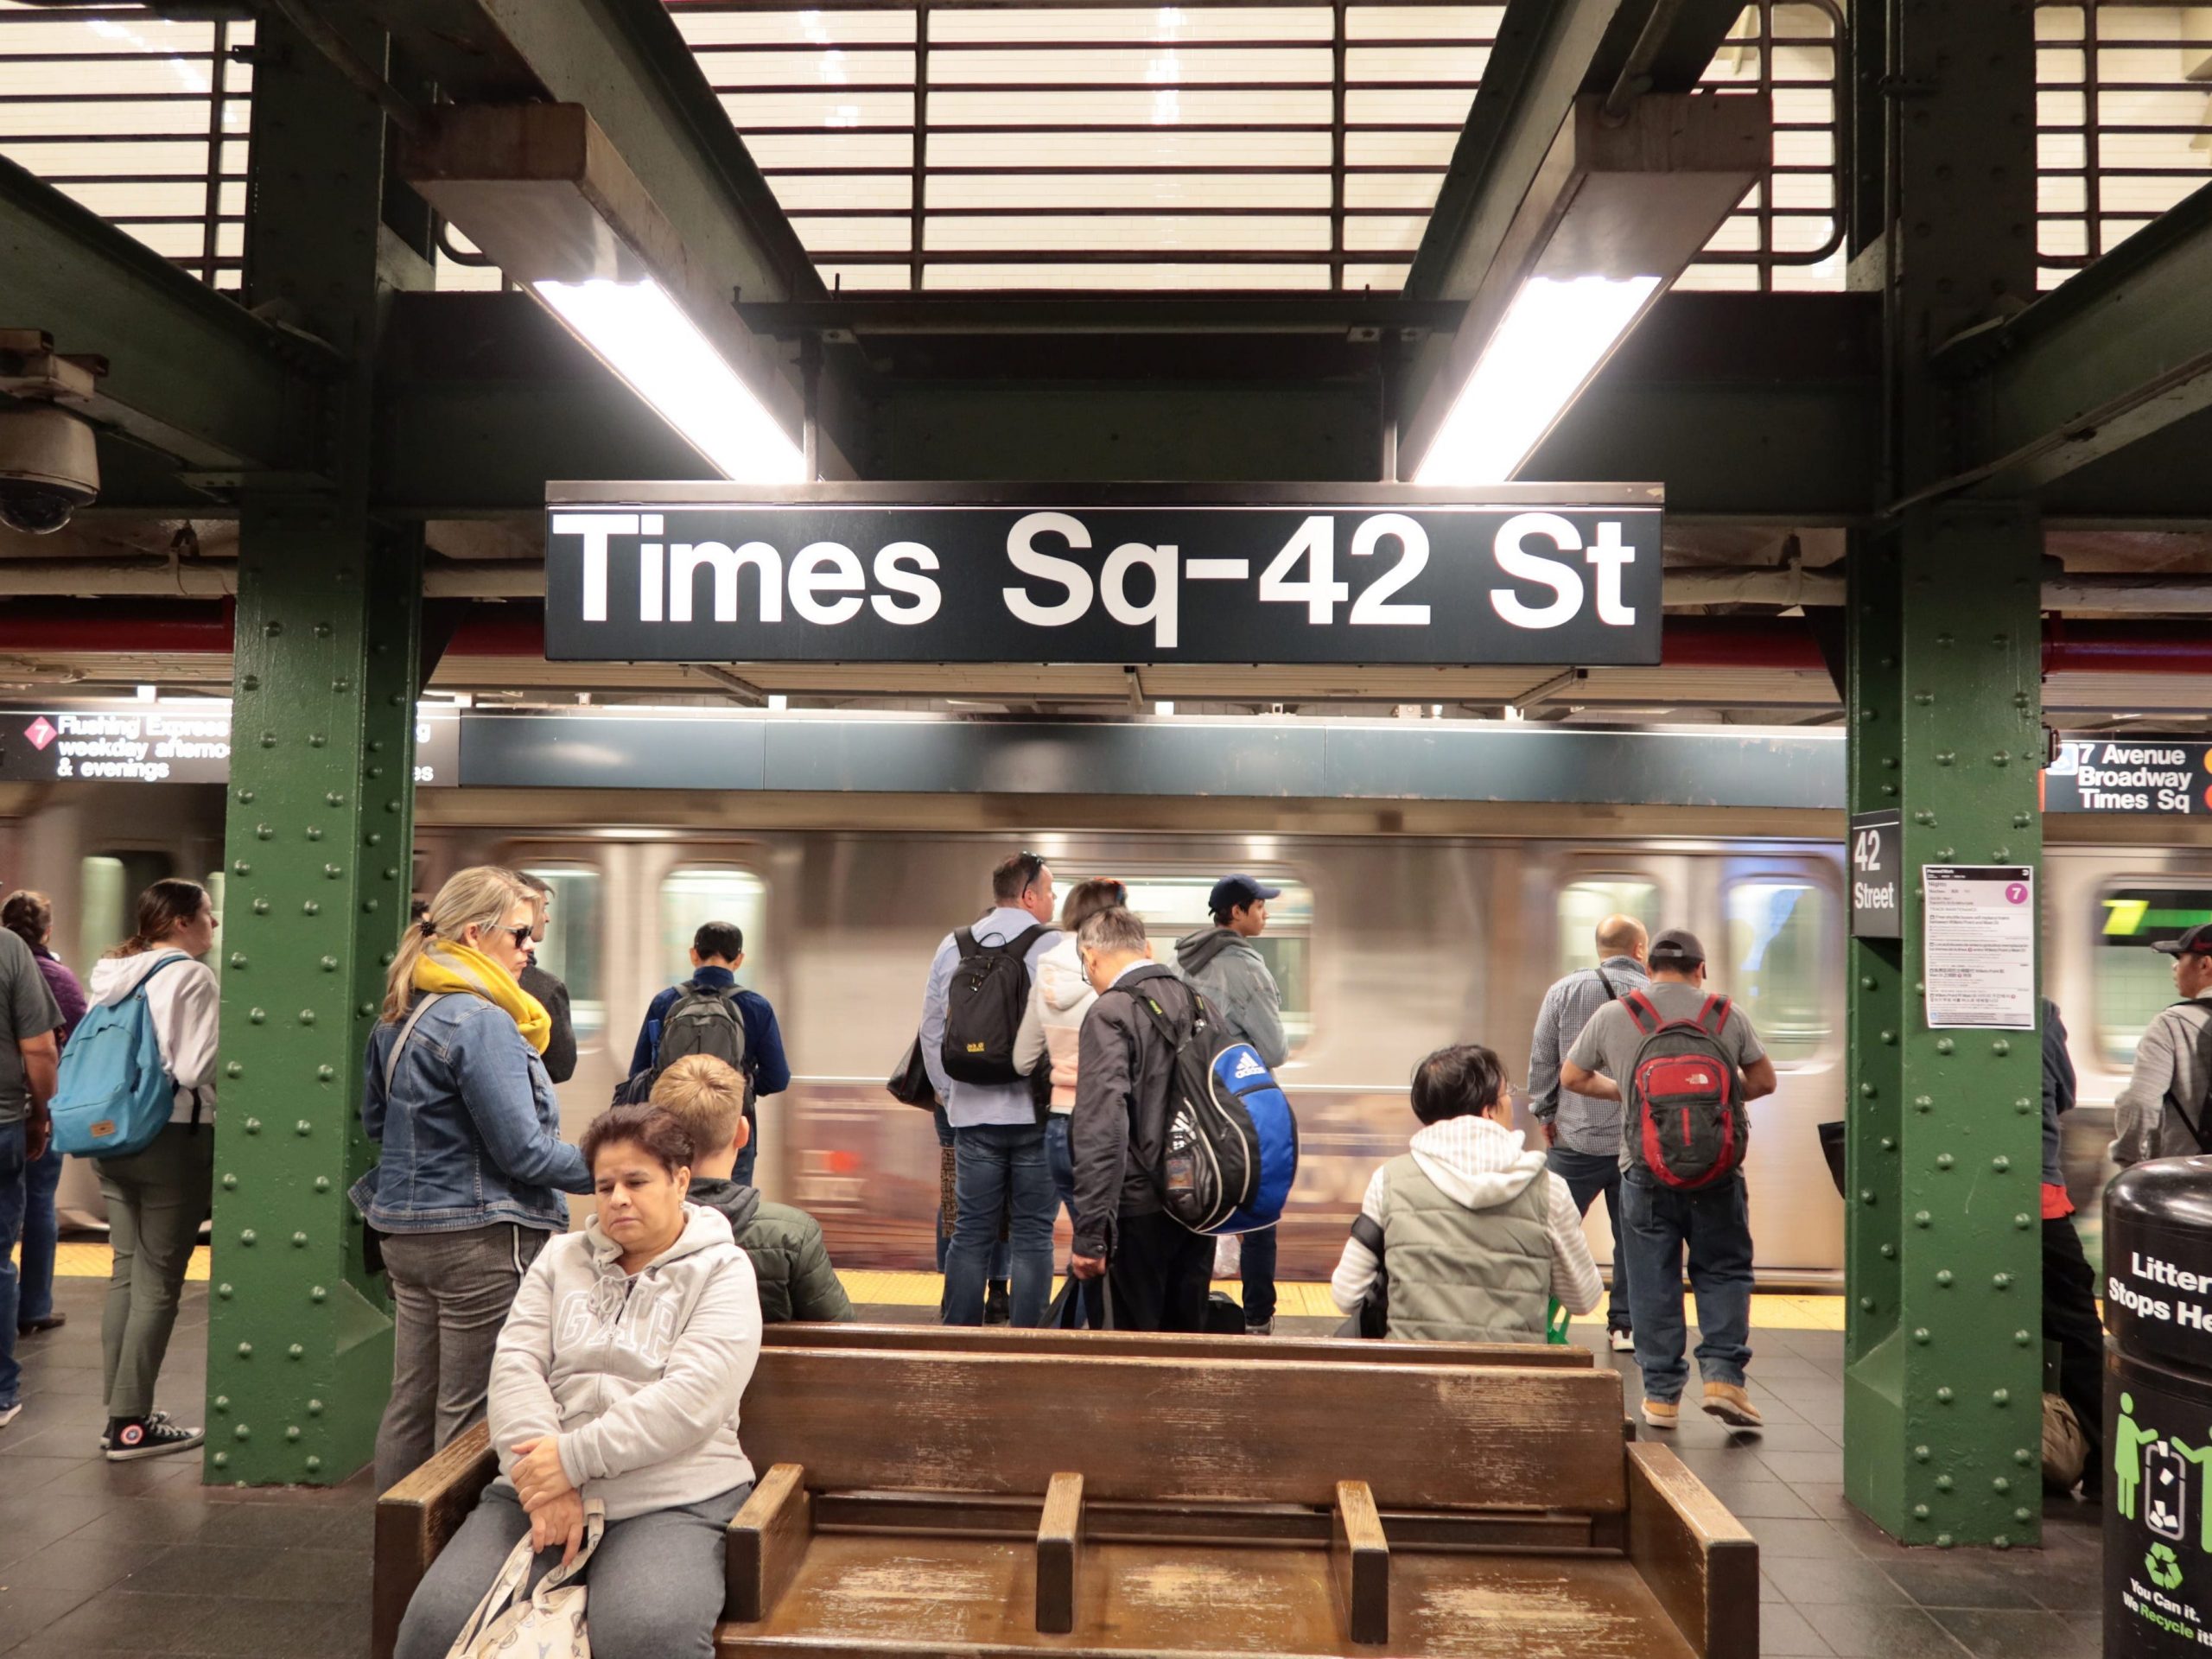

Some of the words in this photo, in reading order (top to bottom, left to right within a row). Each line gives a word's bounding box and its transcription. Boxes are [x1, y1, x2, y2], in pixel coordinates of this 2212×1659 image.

[553, 513, 942, 626] Times
[1003, 512, 1431, 648] Sq-42
[1490, 512, 1637, 629] St
[35, 724, 49, 744] 7
[57, 715, 141, 740] Flushing
[146, 715, 229, 740] Express
[59, 737, 149, 760] weekday
[155, 739, 231, 759] afterno
[2078, 743, 2095, 764] 7
[2101, 744, 2186, 766] Avenue
[57, 757, 73, 777] &
[80, 758, 170, 781] evenings
[2078, 766, 2193, 791] Broadway
[2078, 788, 2149, 810] Times
[2158, 789, 2190, 814] Sq
[1854, 830, 1881, 872] 42
[1854, 881, 1895, 910] Street
[2012, 887, 2023, 900] 7
[2132, 1251, 2212, 1294] Litter
[2108, 1276, 2171, 1319] Stops
[554, 1287, 679, 1367] GAP
[2130, 1577, 2152, 1602] You
[2153, 1591, 2182, 1616] Can
[2183, 1604, 2202, 1624] it.
[2122, 1591, 2139, 1613] We
[2140, 1602, 2195, 1639] Recycle
